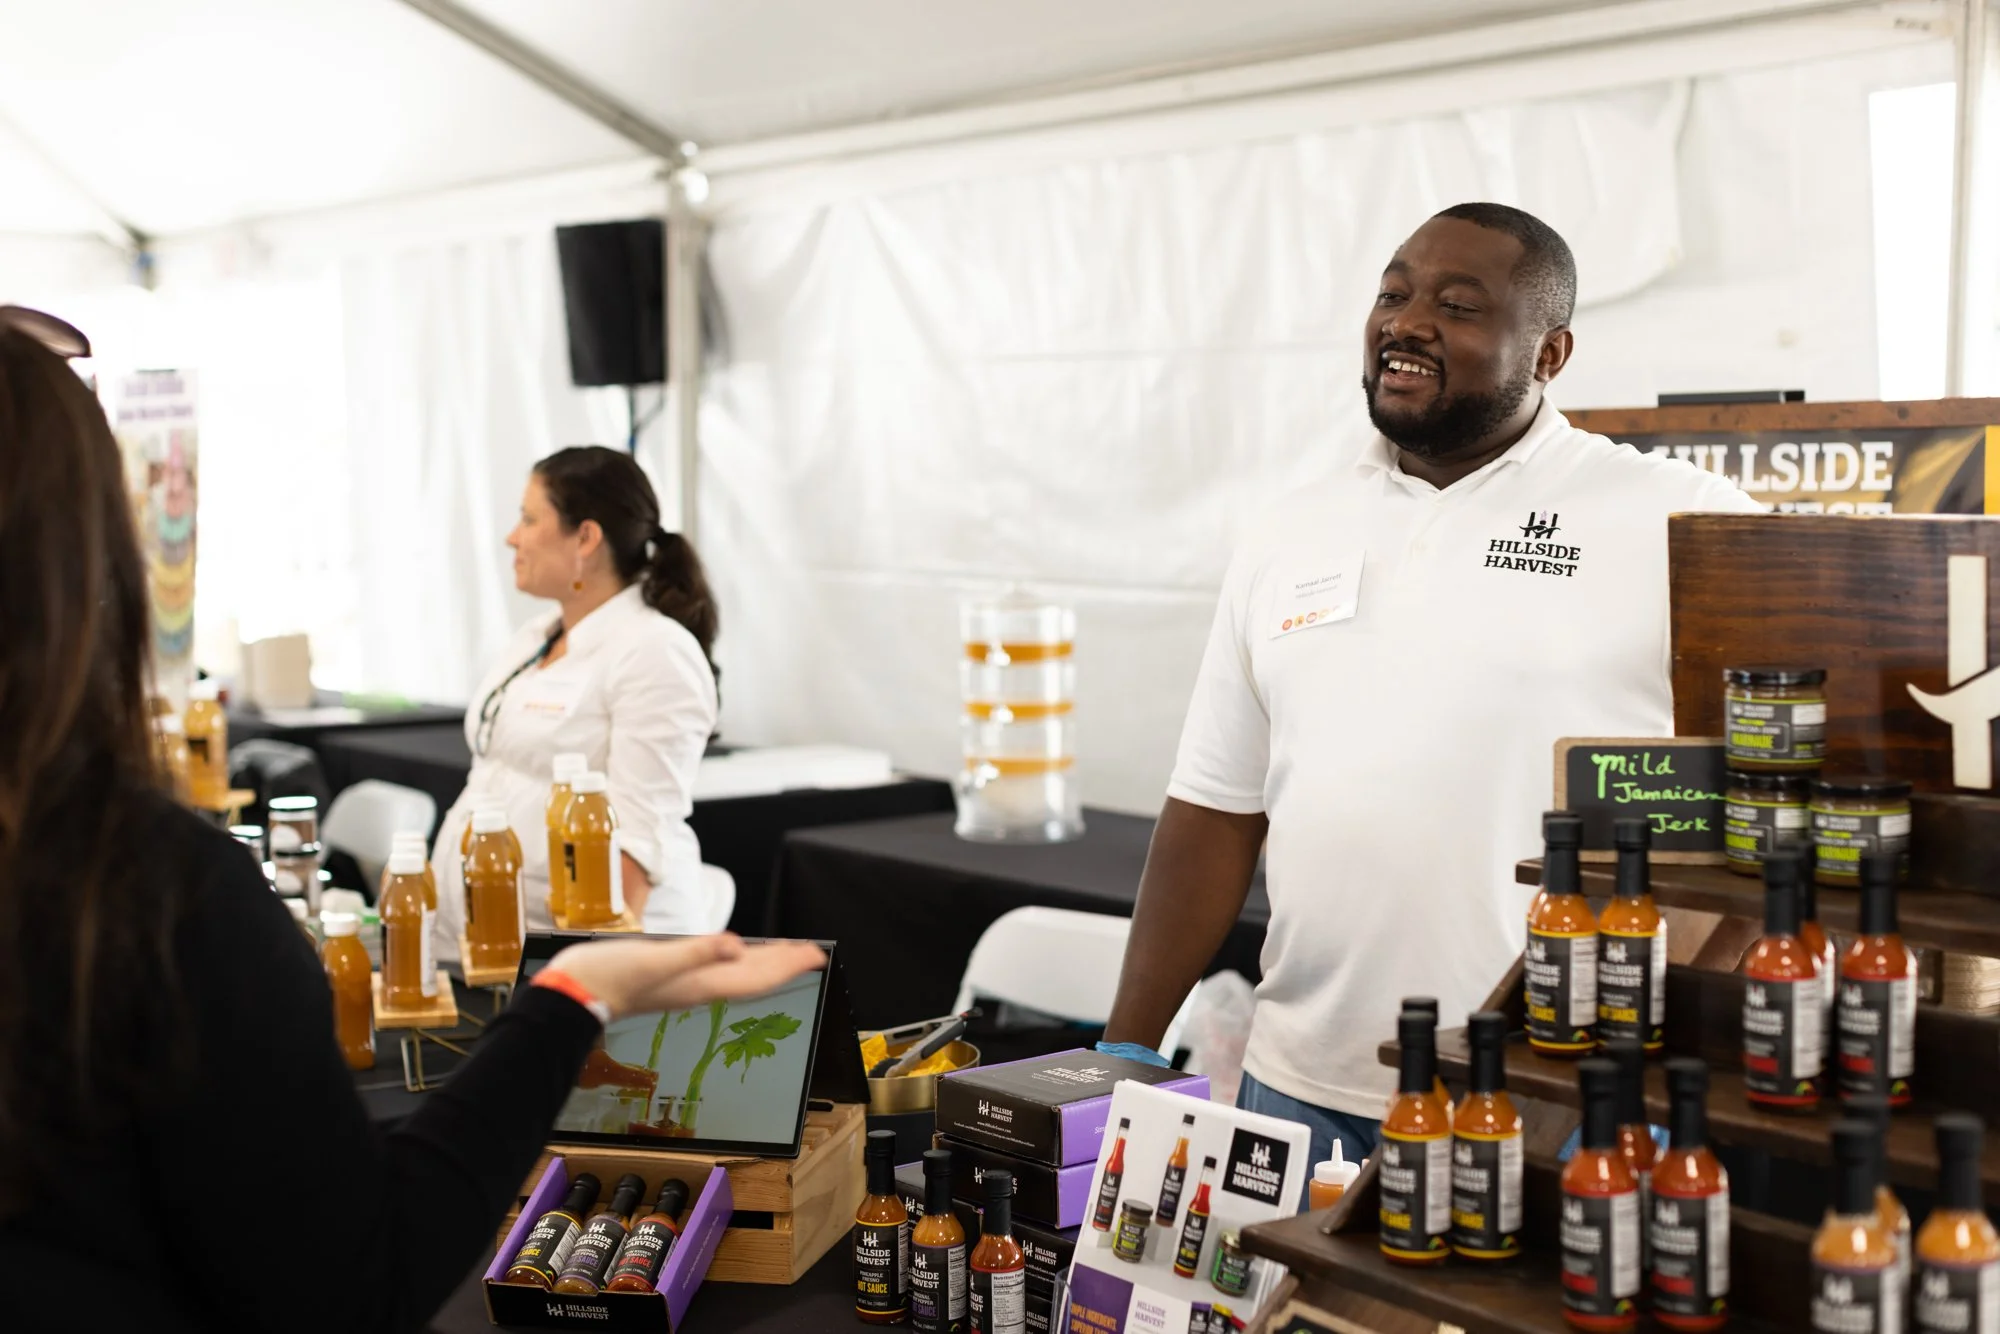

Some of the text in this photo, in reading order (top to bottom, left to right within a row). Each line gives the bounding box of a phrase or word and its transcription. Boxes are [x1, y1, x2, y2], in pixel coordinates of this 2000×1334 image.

[1653, 442, 1893, 492] ILLSIDE
[1488, 539, 1581, 561] HILLSIDE
[1484, 555, 1578, 577] HARVEST
[1591, 752, 1676, 799] Mild
[1612, 782, 1728, 803] Jamaican
[1646, 813, 1711, 833] Jerk
[990, 1112, 1013, 1123] HARVEST
[991, 1105, 1013, 1117] HILLSIDE
[1236, 1161, 1280, 1185] HILLSIDE
[1232, 1174, 1278, 1197] HARVEST
[856, 1245, 891, 1257] HILLSIDE
[1034, 1246, 1058, 1259] HILLSIDE
[856, 1254, 891, 1266] HARVEST
[1034, 1254, 1057, 1266] HARVEST
[867, 1282, 888, 1294] SAUCE
[566, 1304, 609, 1313] HILLSIDE
[567, 1311, 609, 1320] HARVEST
